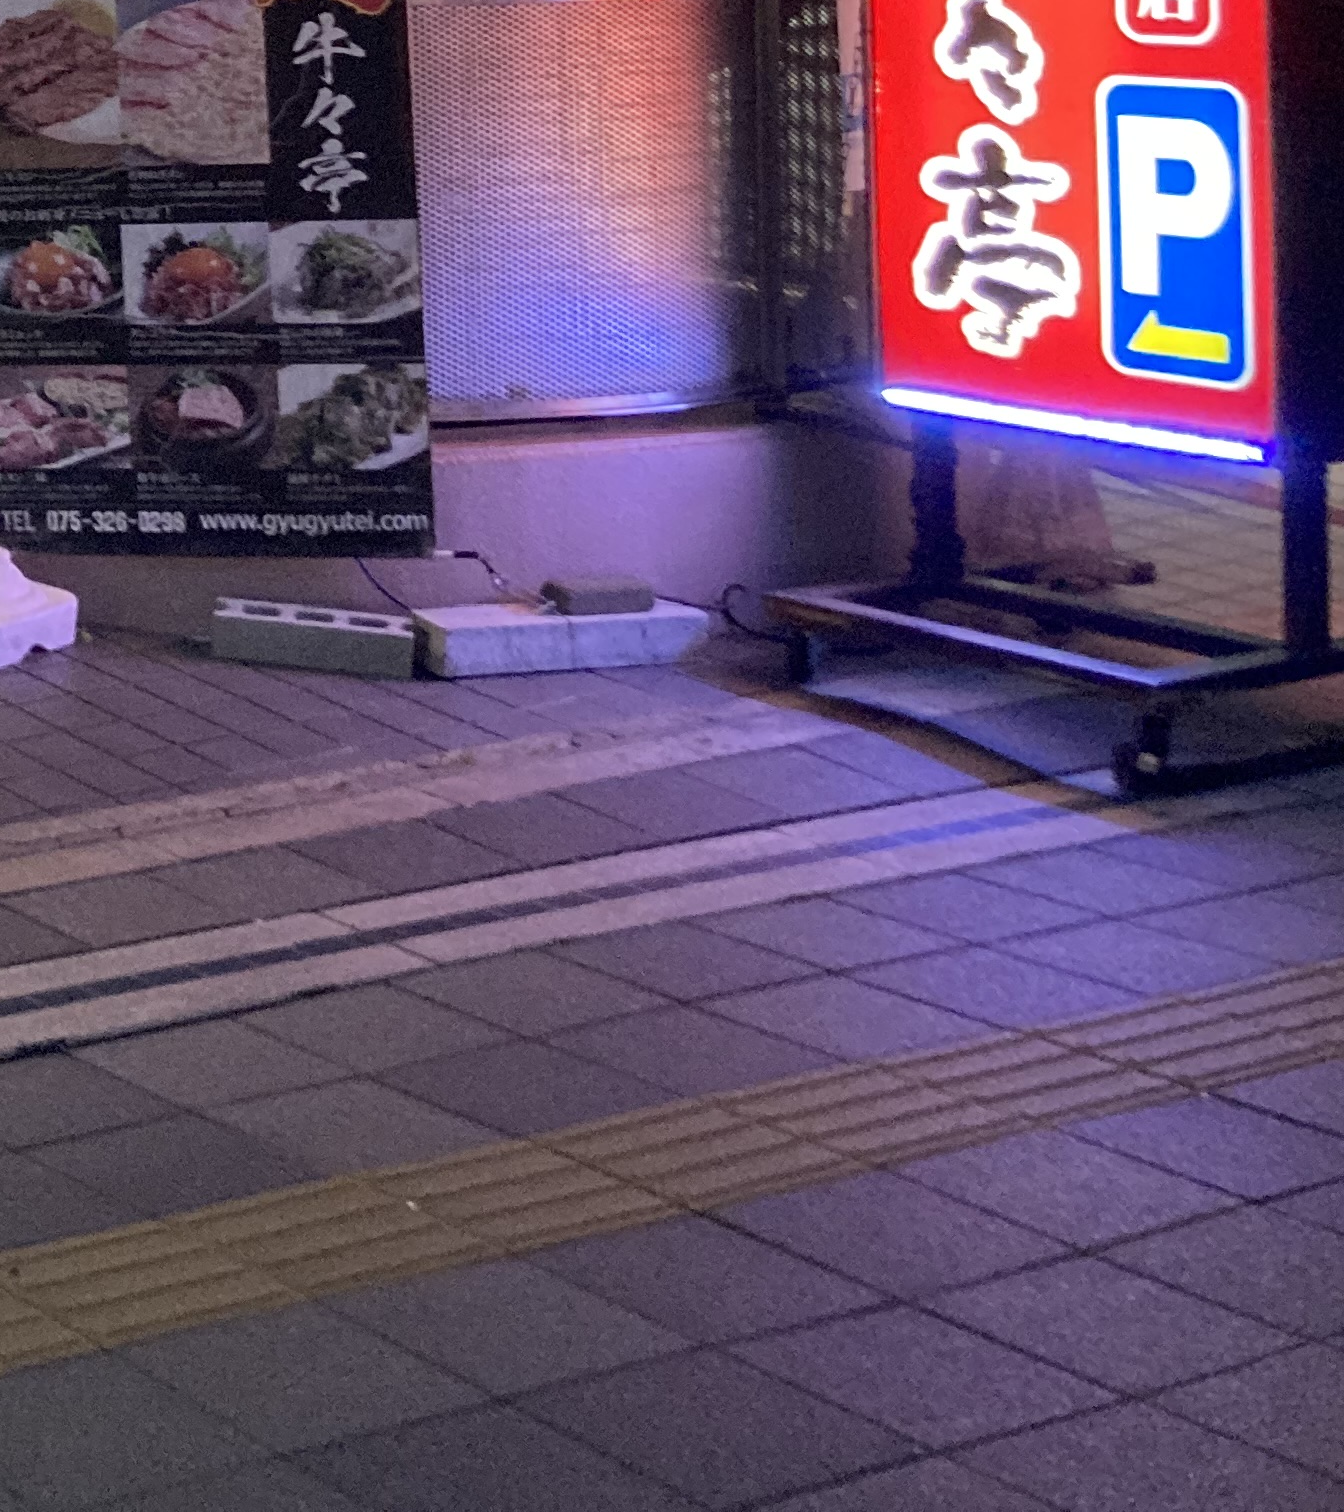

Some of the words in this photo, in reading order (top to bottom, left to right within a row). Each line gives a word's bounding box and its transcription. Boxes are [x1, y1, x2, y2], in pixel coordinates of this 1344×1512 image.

[292, 12, 367, 214] 牛々亭
[1117, 113, 1234, 295] P
[1, 510, 34, 532] TEL
[46, 509, 187, 534] 075-326-0298
[199, 509, 429, 537] www.gyugyutei.com
